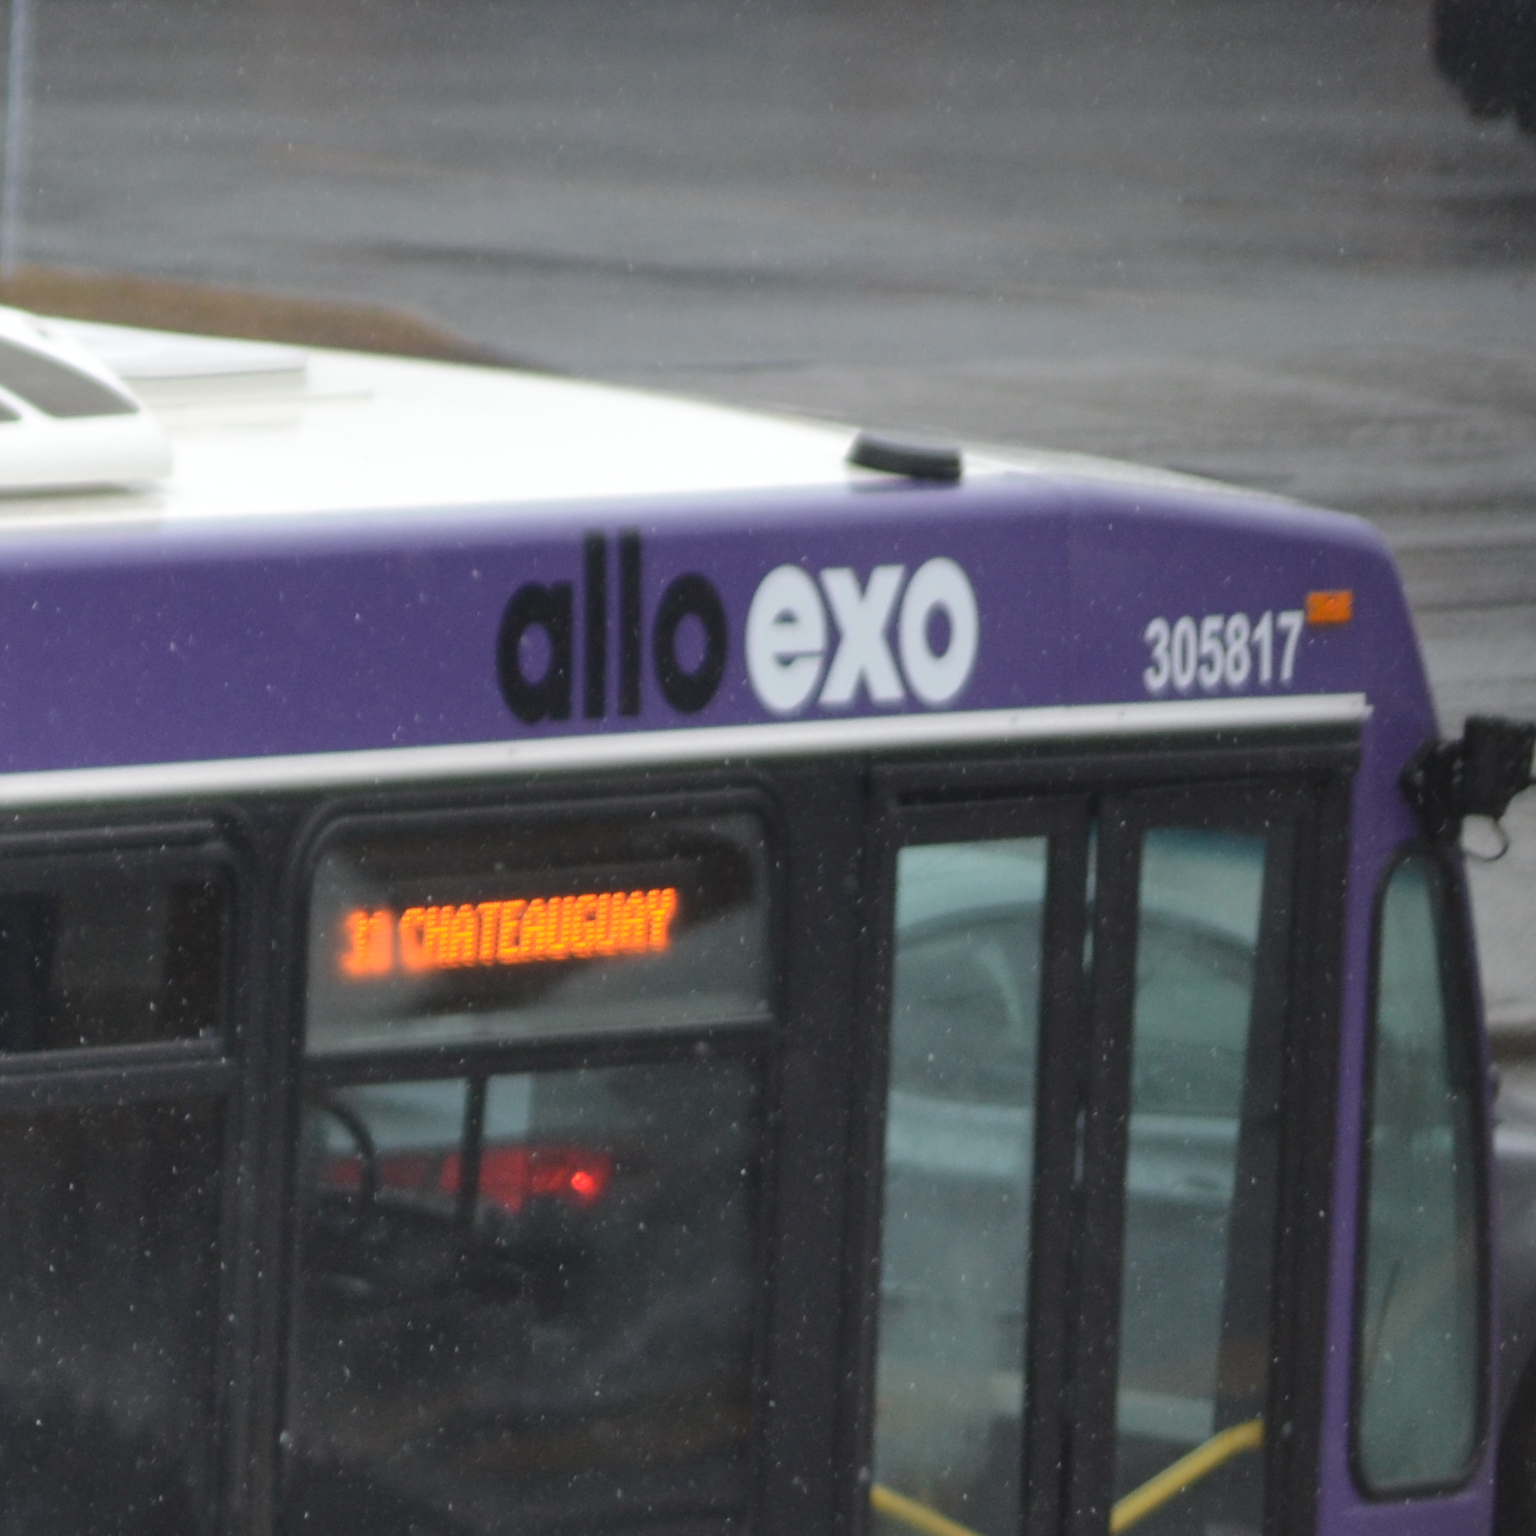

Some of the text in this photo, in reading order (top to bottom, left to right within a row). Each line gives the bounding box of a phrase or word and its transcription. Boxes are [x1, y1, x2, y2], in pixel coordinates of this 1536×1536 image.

[497, 528, 979, 725] allo exo
[1144, 611, 1306, 693] 305817
[399, 888, 678, 972] CHATEAUGUAY
